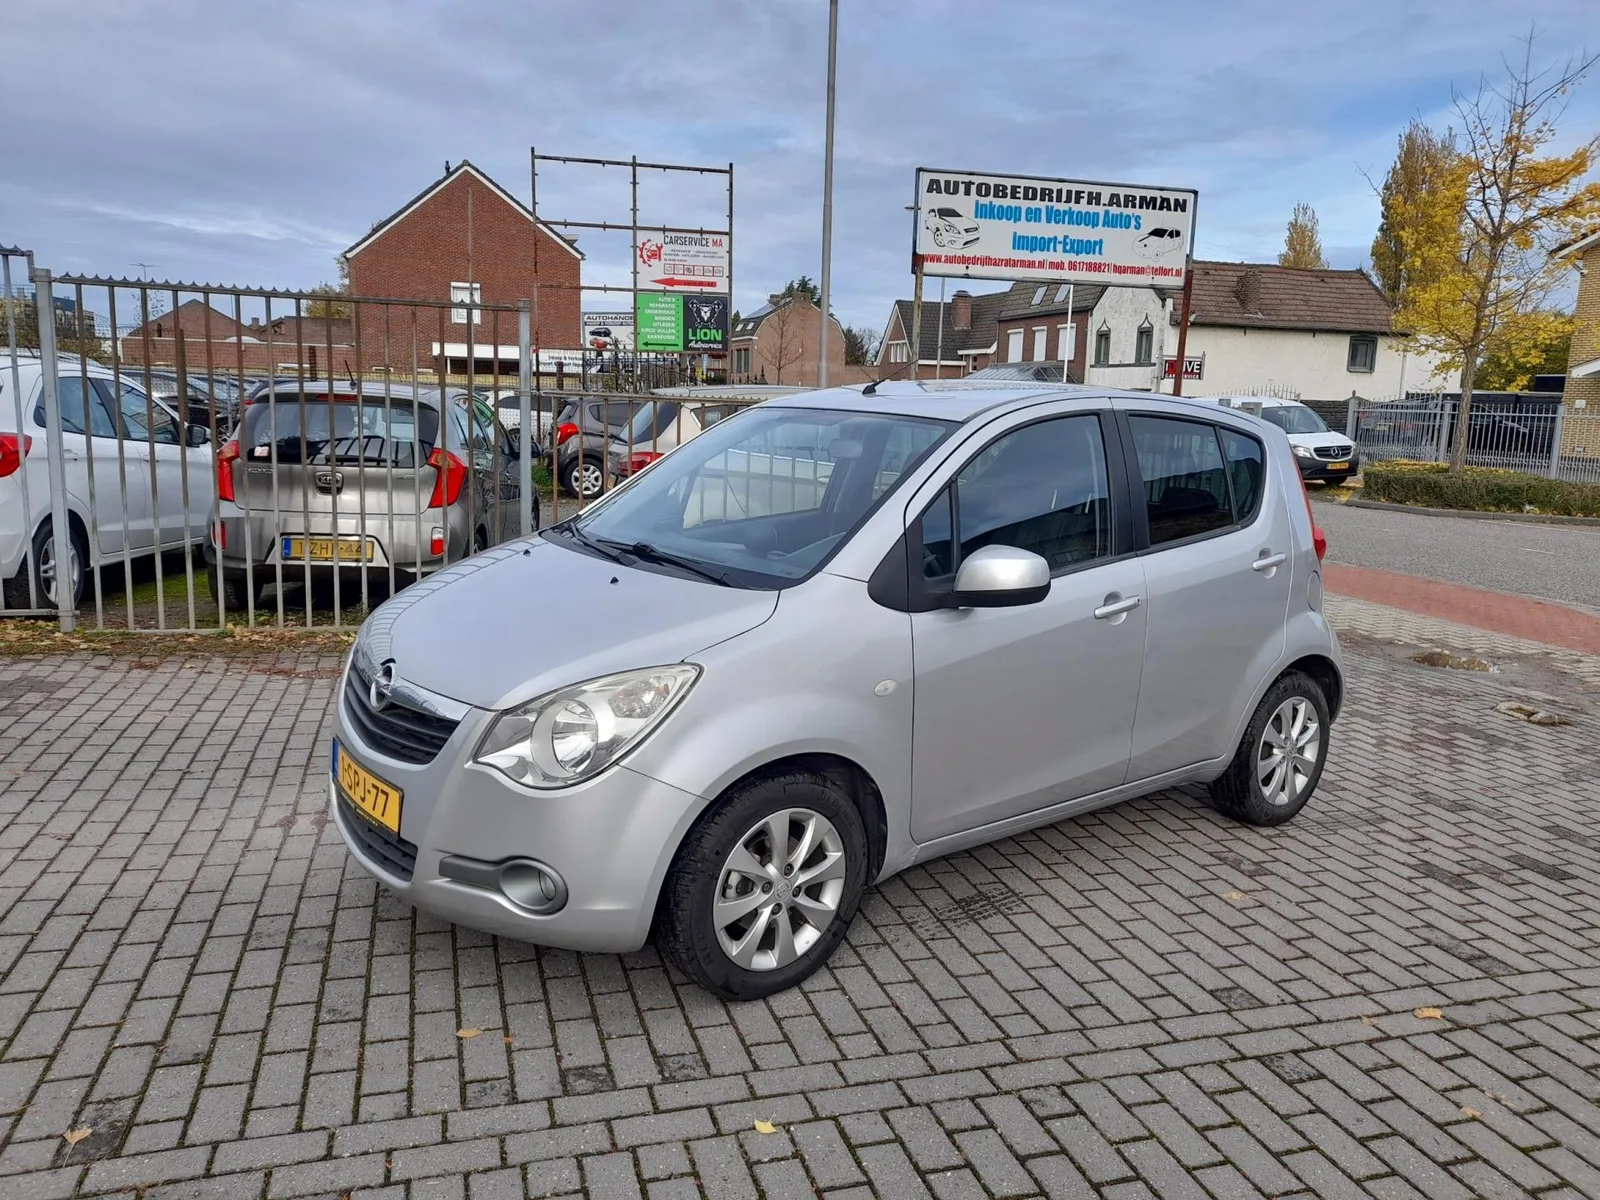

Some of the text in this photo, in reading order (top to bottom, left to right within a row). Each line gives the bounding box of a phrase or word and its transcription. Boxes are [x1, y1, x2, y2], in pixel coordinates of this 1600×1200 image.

[926, 178, 1187, 213] AUTOBEDRIJFH.ARMAN
[974, 200, 1142, 230] Inkoop en Verkoop Auto's
[663, 235, 723, 248] CARSERVICE MA
[1012, 231, 1104, 256] Import-Export
[1048, 260, 1067, 271] mob.
[688, 328, 722, 341] LION
[688, 340, 723, 349] Autoservice
